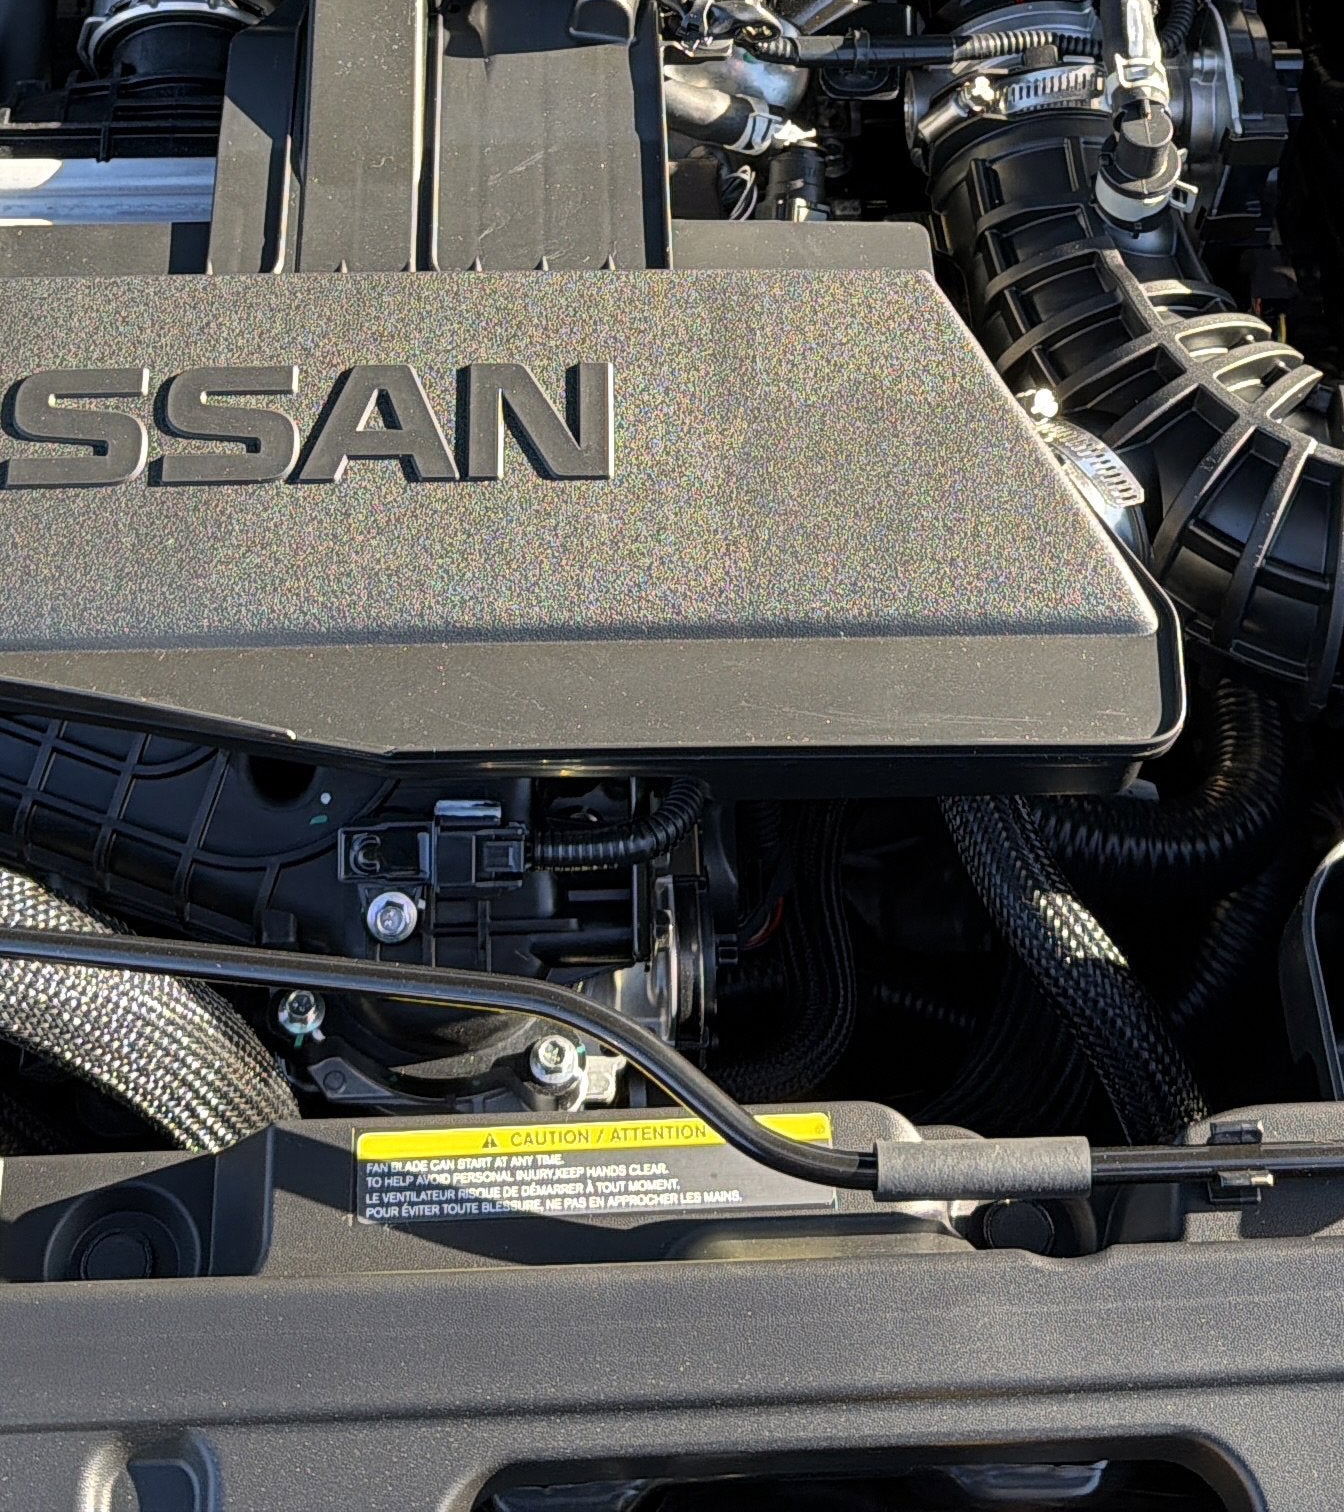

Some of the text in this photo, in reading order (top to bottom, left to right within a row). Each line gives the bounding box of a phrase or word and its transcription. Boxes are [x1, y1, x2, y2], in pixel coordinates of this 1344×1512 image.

[510, 1128, 589, 1147] CAUTION
[609, 1124, 706, 1143] ATTENTION
[366, 1154, 565, 1174] FAN BLADE CAN START AT ANY TIME.
[366, 1176, 381, 1188] TO
[384, 1174, 414, 1187] HELP
[415, 1172, 451, 1186] AVOID
[453, 1170, 514, 1184] PERSONAL
[586, 1164, 627, 1178] HANDS
[629, 1162, 669, 1175] CLEAR.
[365, 1177, 681, 1204] LE VENTILATEUR RISQUE DE DÉMARRER À TOUT MOMENT.
[365, 1189, 743, 1218] POUR ÉVITER TOUTE BLESSURE, NE PAS EN APPROCHER LES MAINS.
